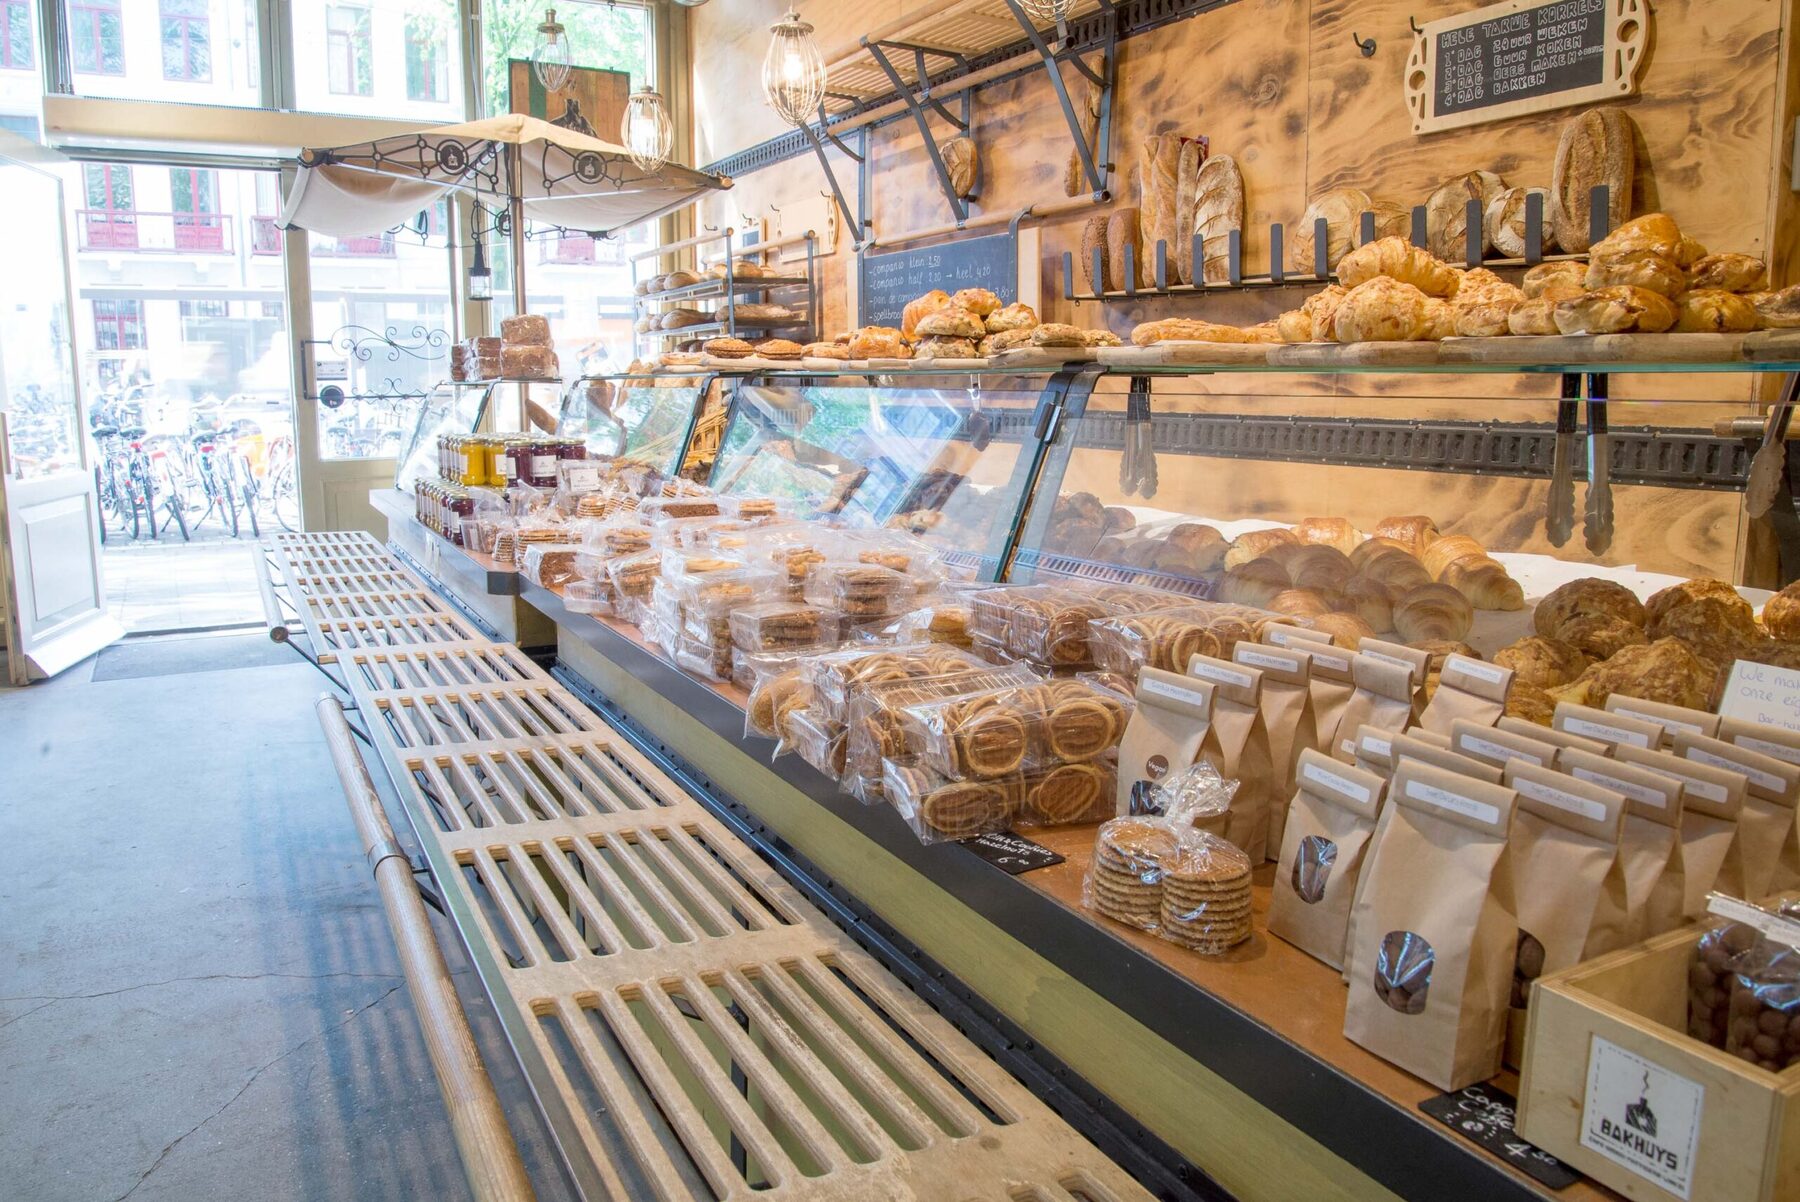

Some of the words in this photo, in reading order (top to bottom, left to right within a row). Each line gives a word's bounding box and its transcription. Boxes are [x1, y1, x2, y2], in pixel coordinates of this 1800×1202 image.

[1441, 27, 1475, 48] HELE
[1482, 13, 1531, 38] TARWE
[1537, 0, 1604, 26] KORRELS
[1537, 17, 1588, 40] WEKEN
[1536, 34, 1582, 57] KOKEN
[1493, 63, 1526, 81] DEEG
[1531, 50, 1577, 73] MAKEN
[1493, 71, 1546, 95] BAKKEN
[1600, 1118, 1678, 1171] BAKHUYS
